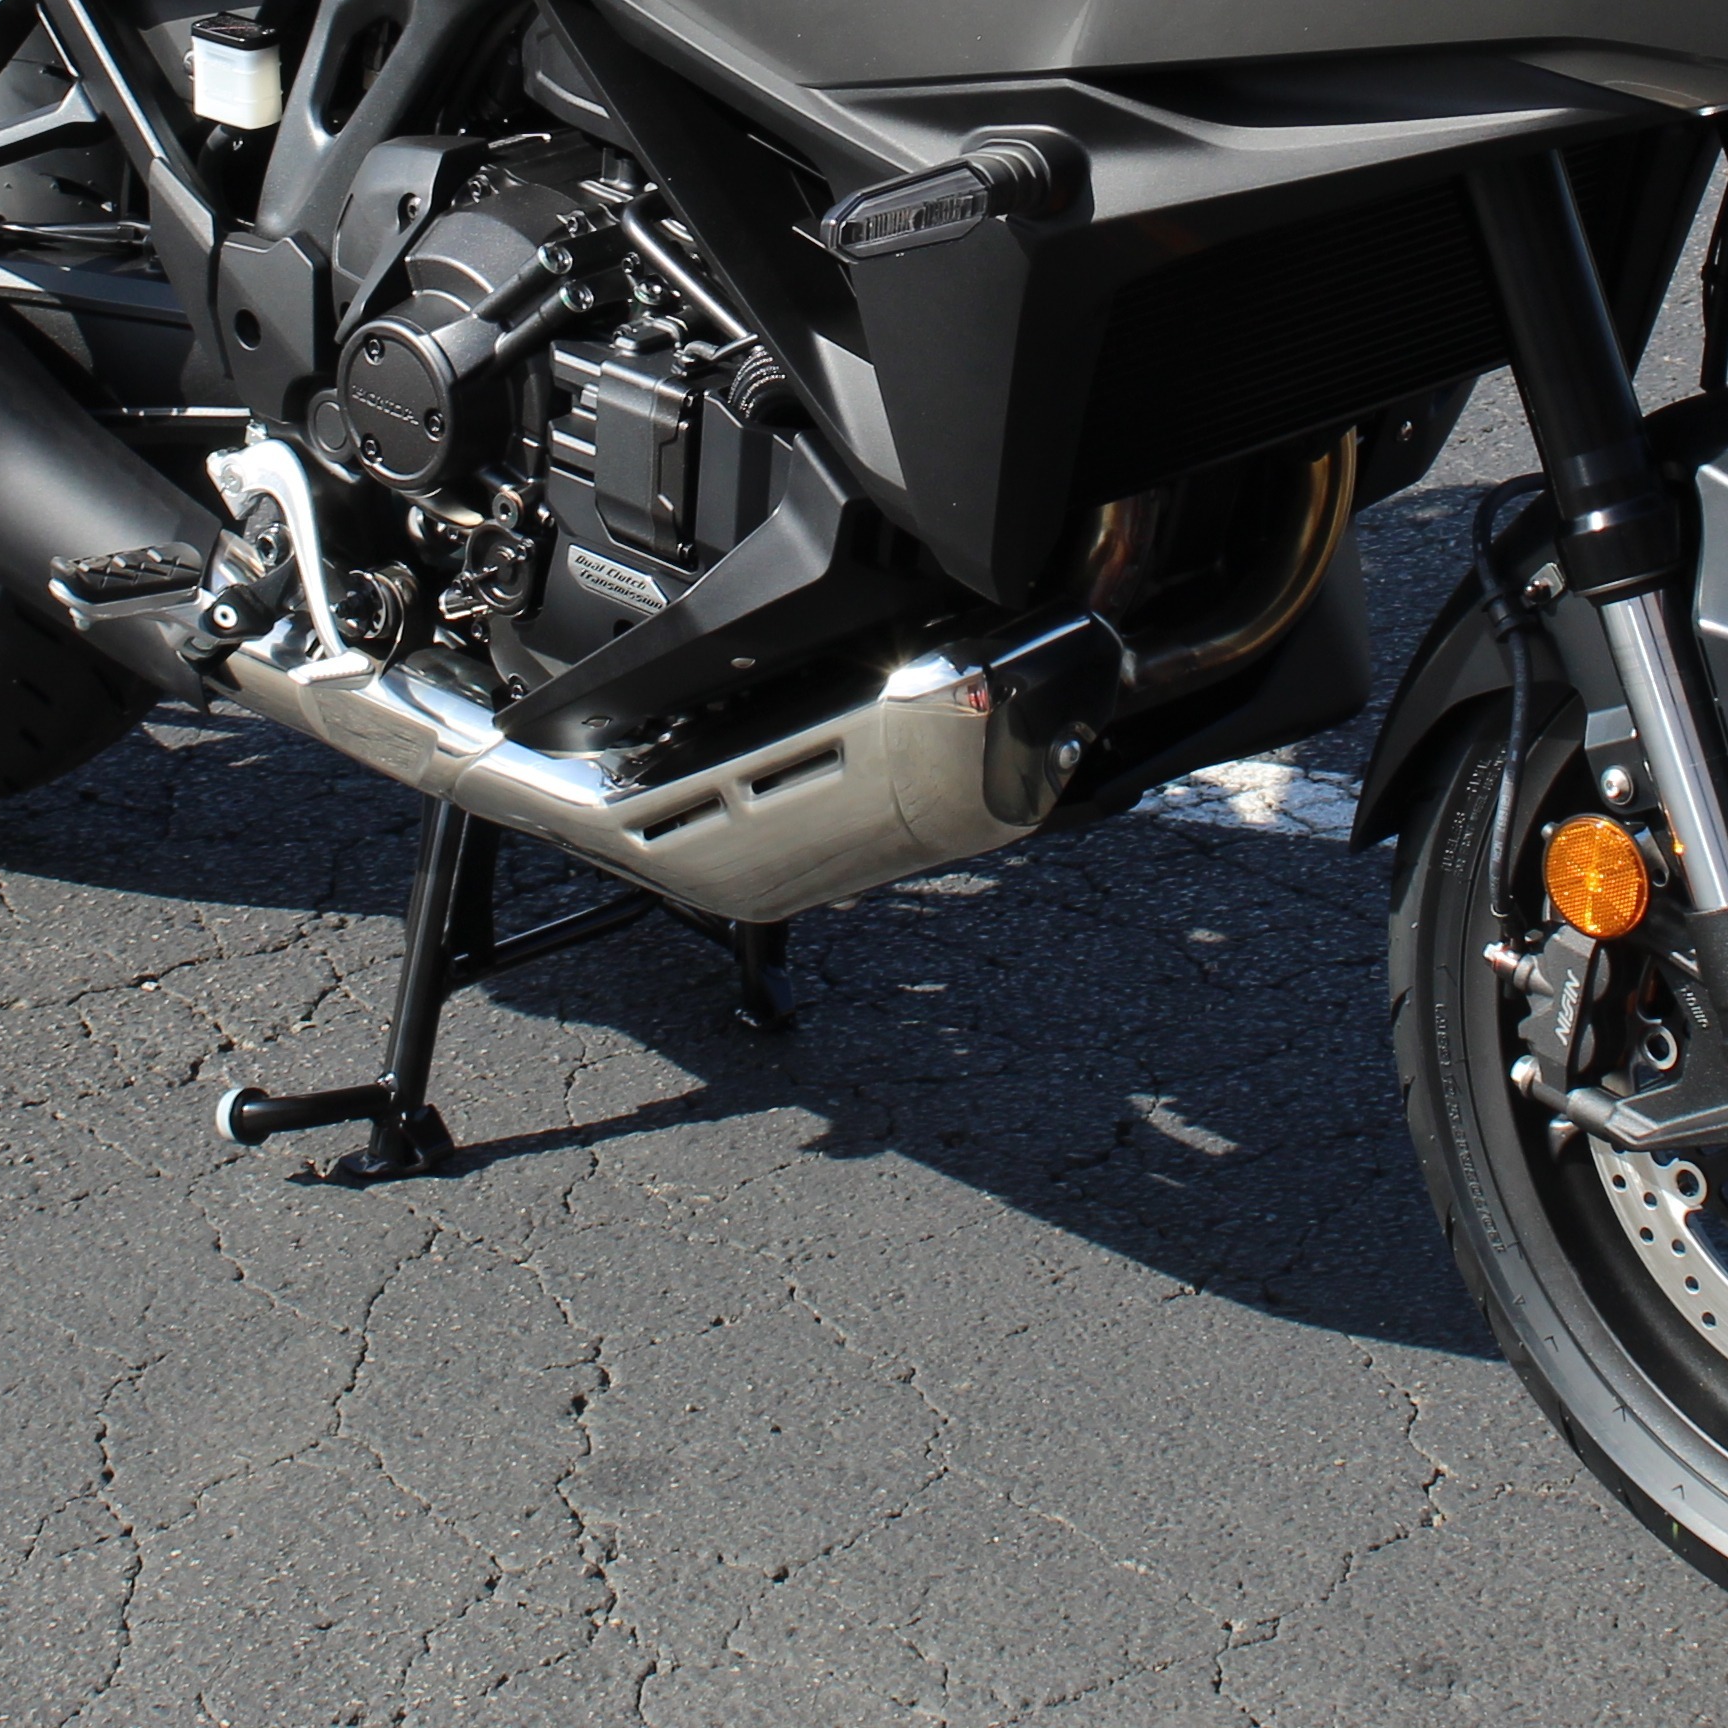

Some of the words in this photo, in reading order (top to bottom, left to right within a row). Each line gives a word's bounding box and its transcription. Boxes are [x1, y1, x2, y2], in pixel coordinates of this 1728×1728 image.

[351, 384, 421, 426] HONDA
[574, 554, 606, 573] Dual
[605, 567, 647, 591] Clutch
[579, 568, 663, 610] Transmission
[1553, 968, 1582, 1048] NISSIN
